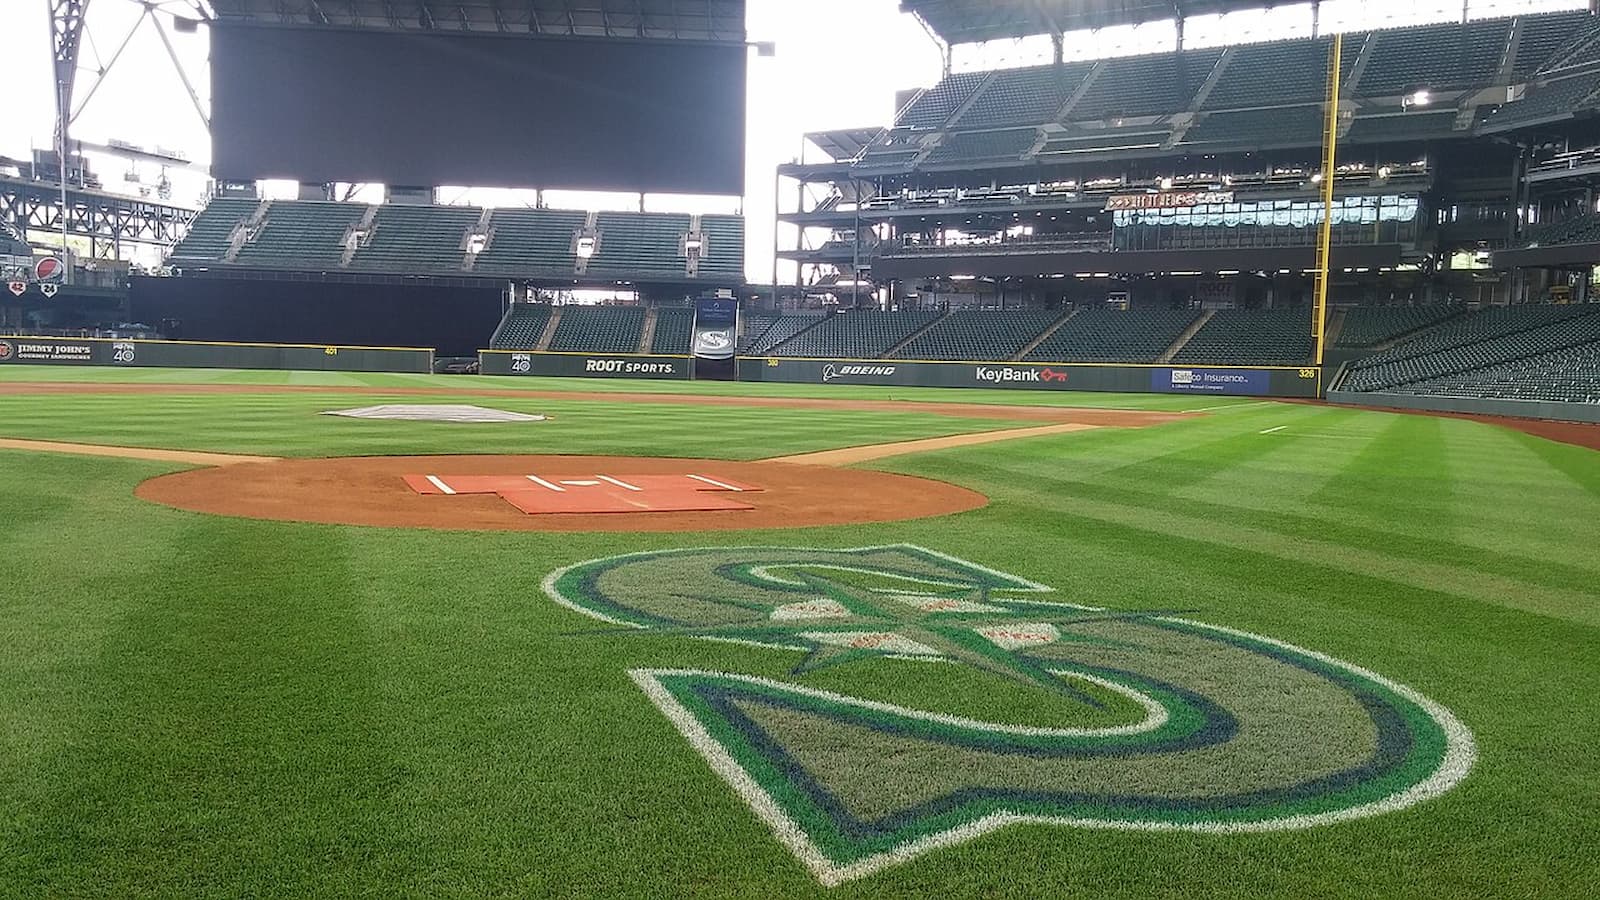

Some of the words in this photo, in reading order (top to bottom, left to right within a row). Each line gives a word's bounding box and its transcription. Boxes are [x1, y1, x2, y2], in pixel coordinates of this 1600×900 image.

[43, 284, 55, 293] 24
[18, 344, 53, 353] JIMMY
[55, 346, 91, 354] JOHN'S
[586, 359, 624, 371] ROOT
[626, 362, 673, 373] SPORTS
[840, 365, 895, 375] BOEING
[976, 367, 1039, 382] KeyBank
[1298, 369, 1314, 378] 326
